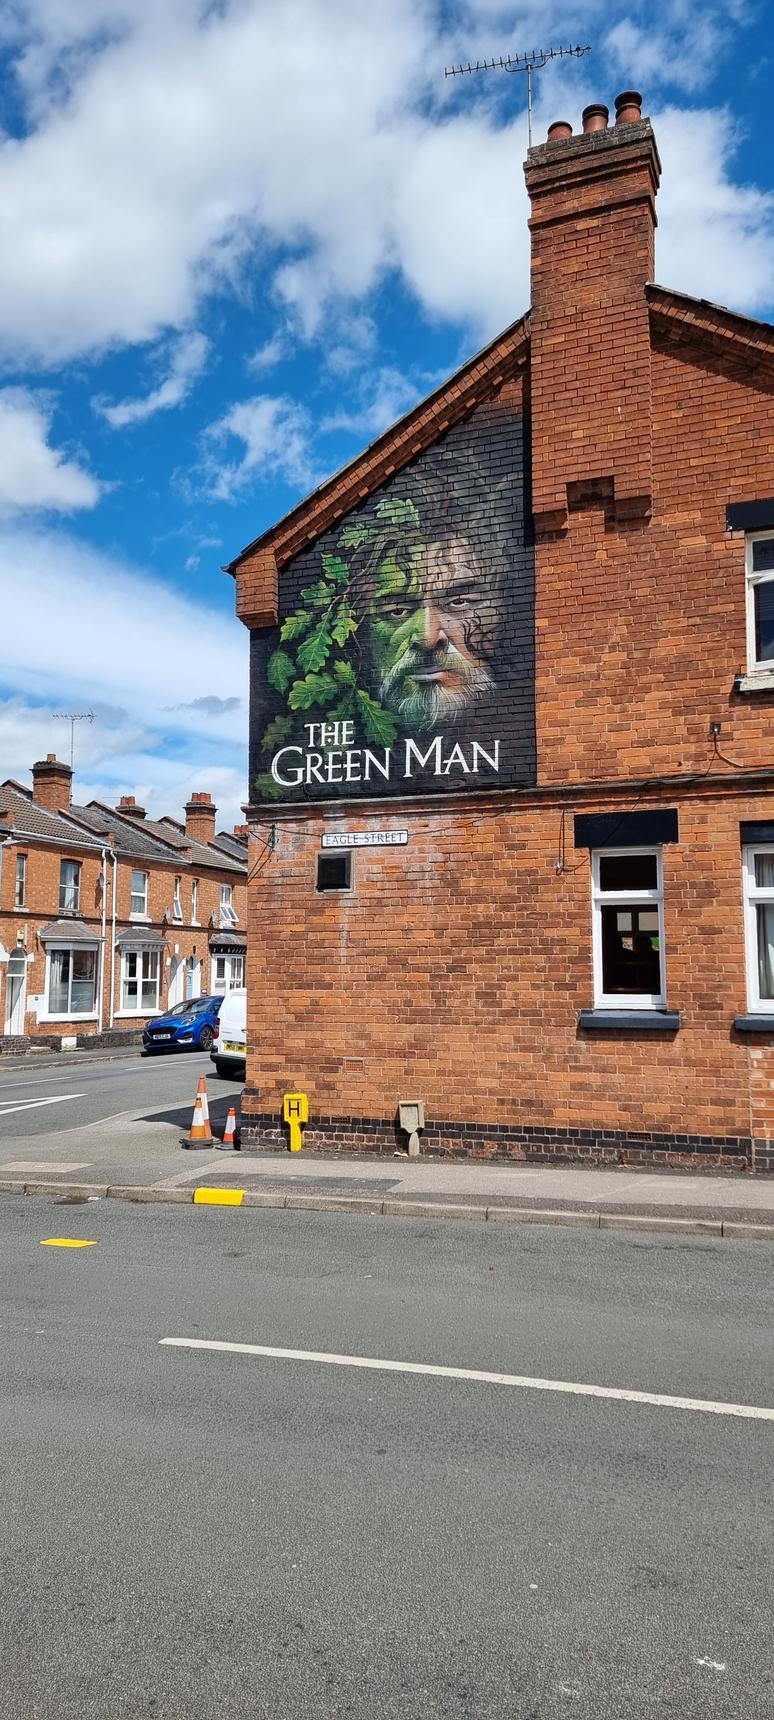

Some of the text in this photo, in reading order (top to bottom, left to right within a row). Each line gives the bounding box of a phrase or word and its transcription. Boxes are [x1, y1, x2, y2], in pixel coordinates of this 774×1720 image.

[304, 720, 354, 747] THE
[271, 736, 500, 786] GREEN MAN
[325, 832, 404, 845] EAGLE STREET
[288, 1101, 299, 1117] H
